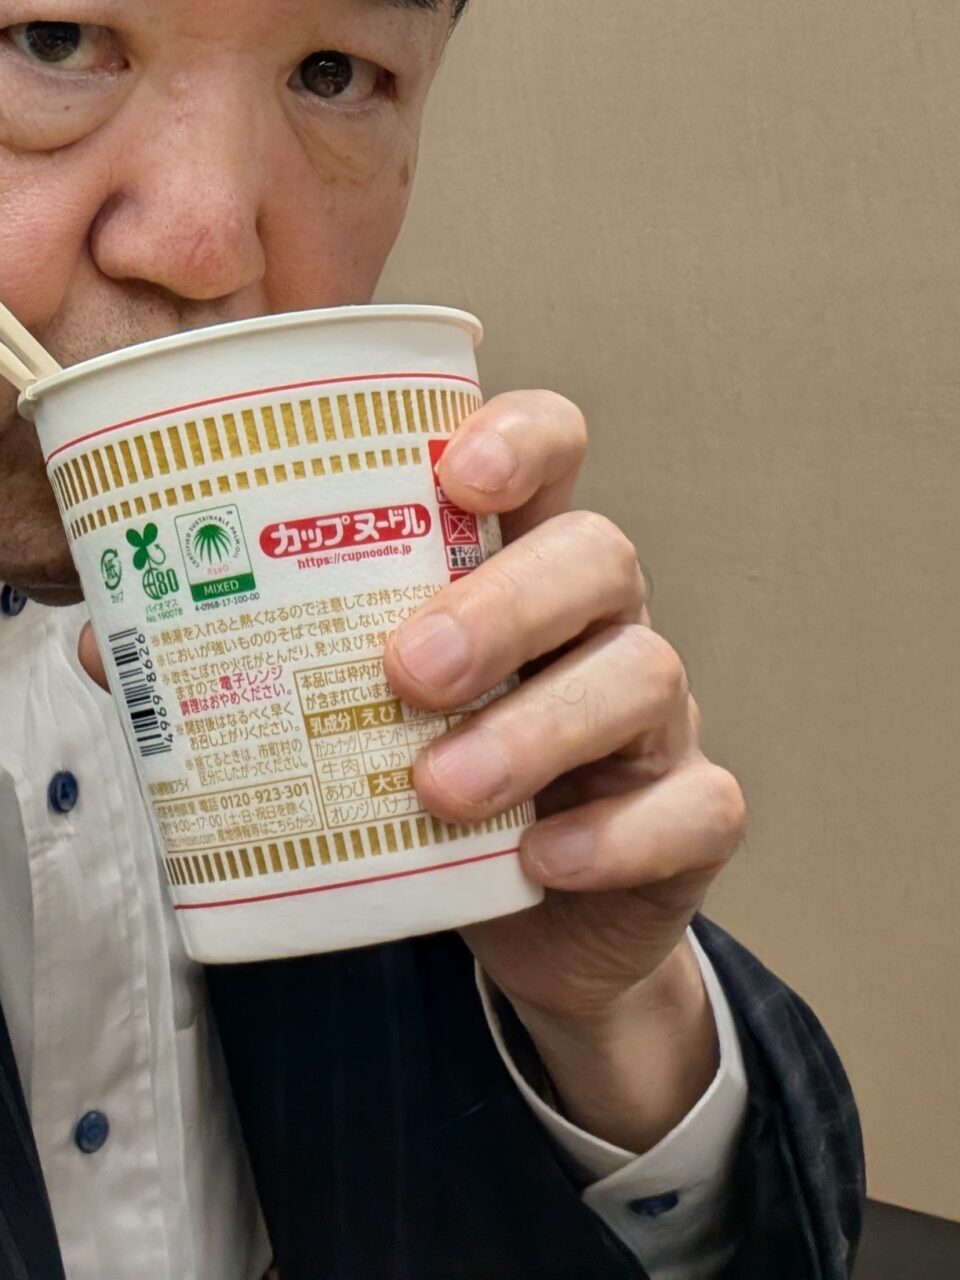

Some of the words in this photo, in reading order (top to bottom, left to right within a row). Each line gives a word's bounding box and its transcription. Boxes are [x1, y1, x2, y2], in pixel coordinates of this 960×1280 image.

[297, 543, 412, 570] https://cupnoodle.jp
[203, 579, 240, 597] MIXED
[194, 591, 261, 613] 4-0968-17-100-00
[309, 713, 352, 736] 乳成分
[362, 704, 397, 726] えび
[321, 757, 360, 779] 牛肉
[369, 751, 406, 771] いか
[325, 779, 366, 801] あわび
[374, 771, 410, 795] 大豆
[330, 799, 372, 824] オレンジ
[376, 793, 416, 816] バナナ
